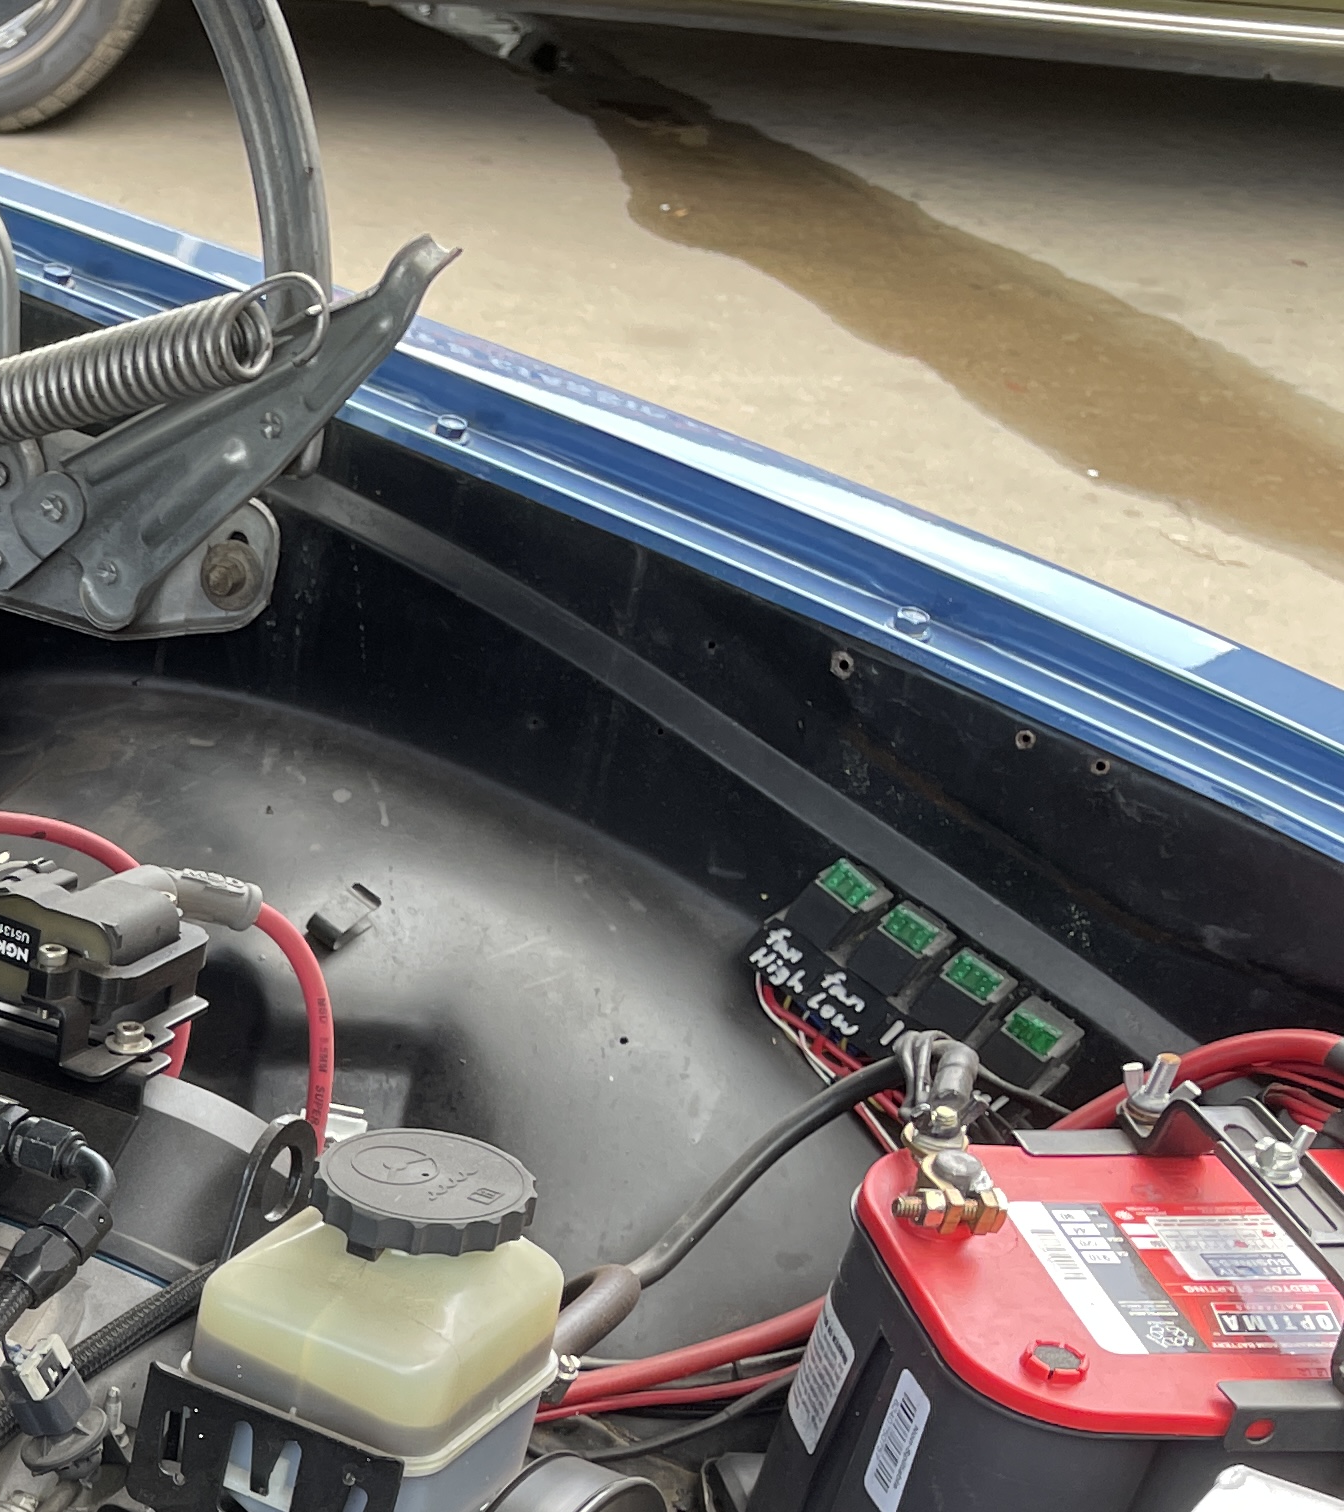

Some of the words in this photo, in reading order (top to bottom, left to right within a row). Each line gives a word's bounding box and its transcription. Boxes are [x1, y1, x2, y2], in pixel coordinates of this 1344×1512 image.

[182, 867, 246, 890] MSD
[749, 948, 806, 994] High
[820, 971, 866, 1013] fan
[311, 1084, 326, 1126] SUPER
[1182, 1283, 1253, 1294] STARTING
[1221, 1314, 1334, 1331] OPTIMA
